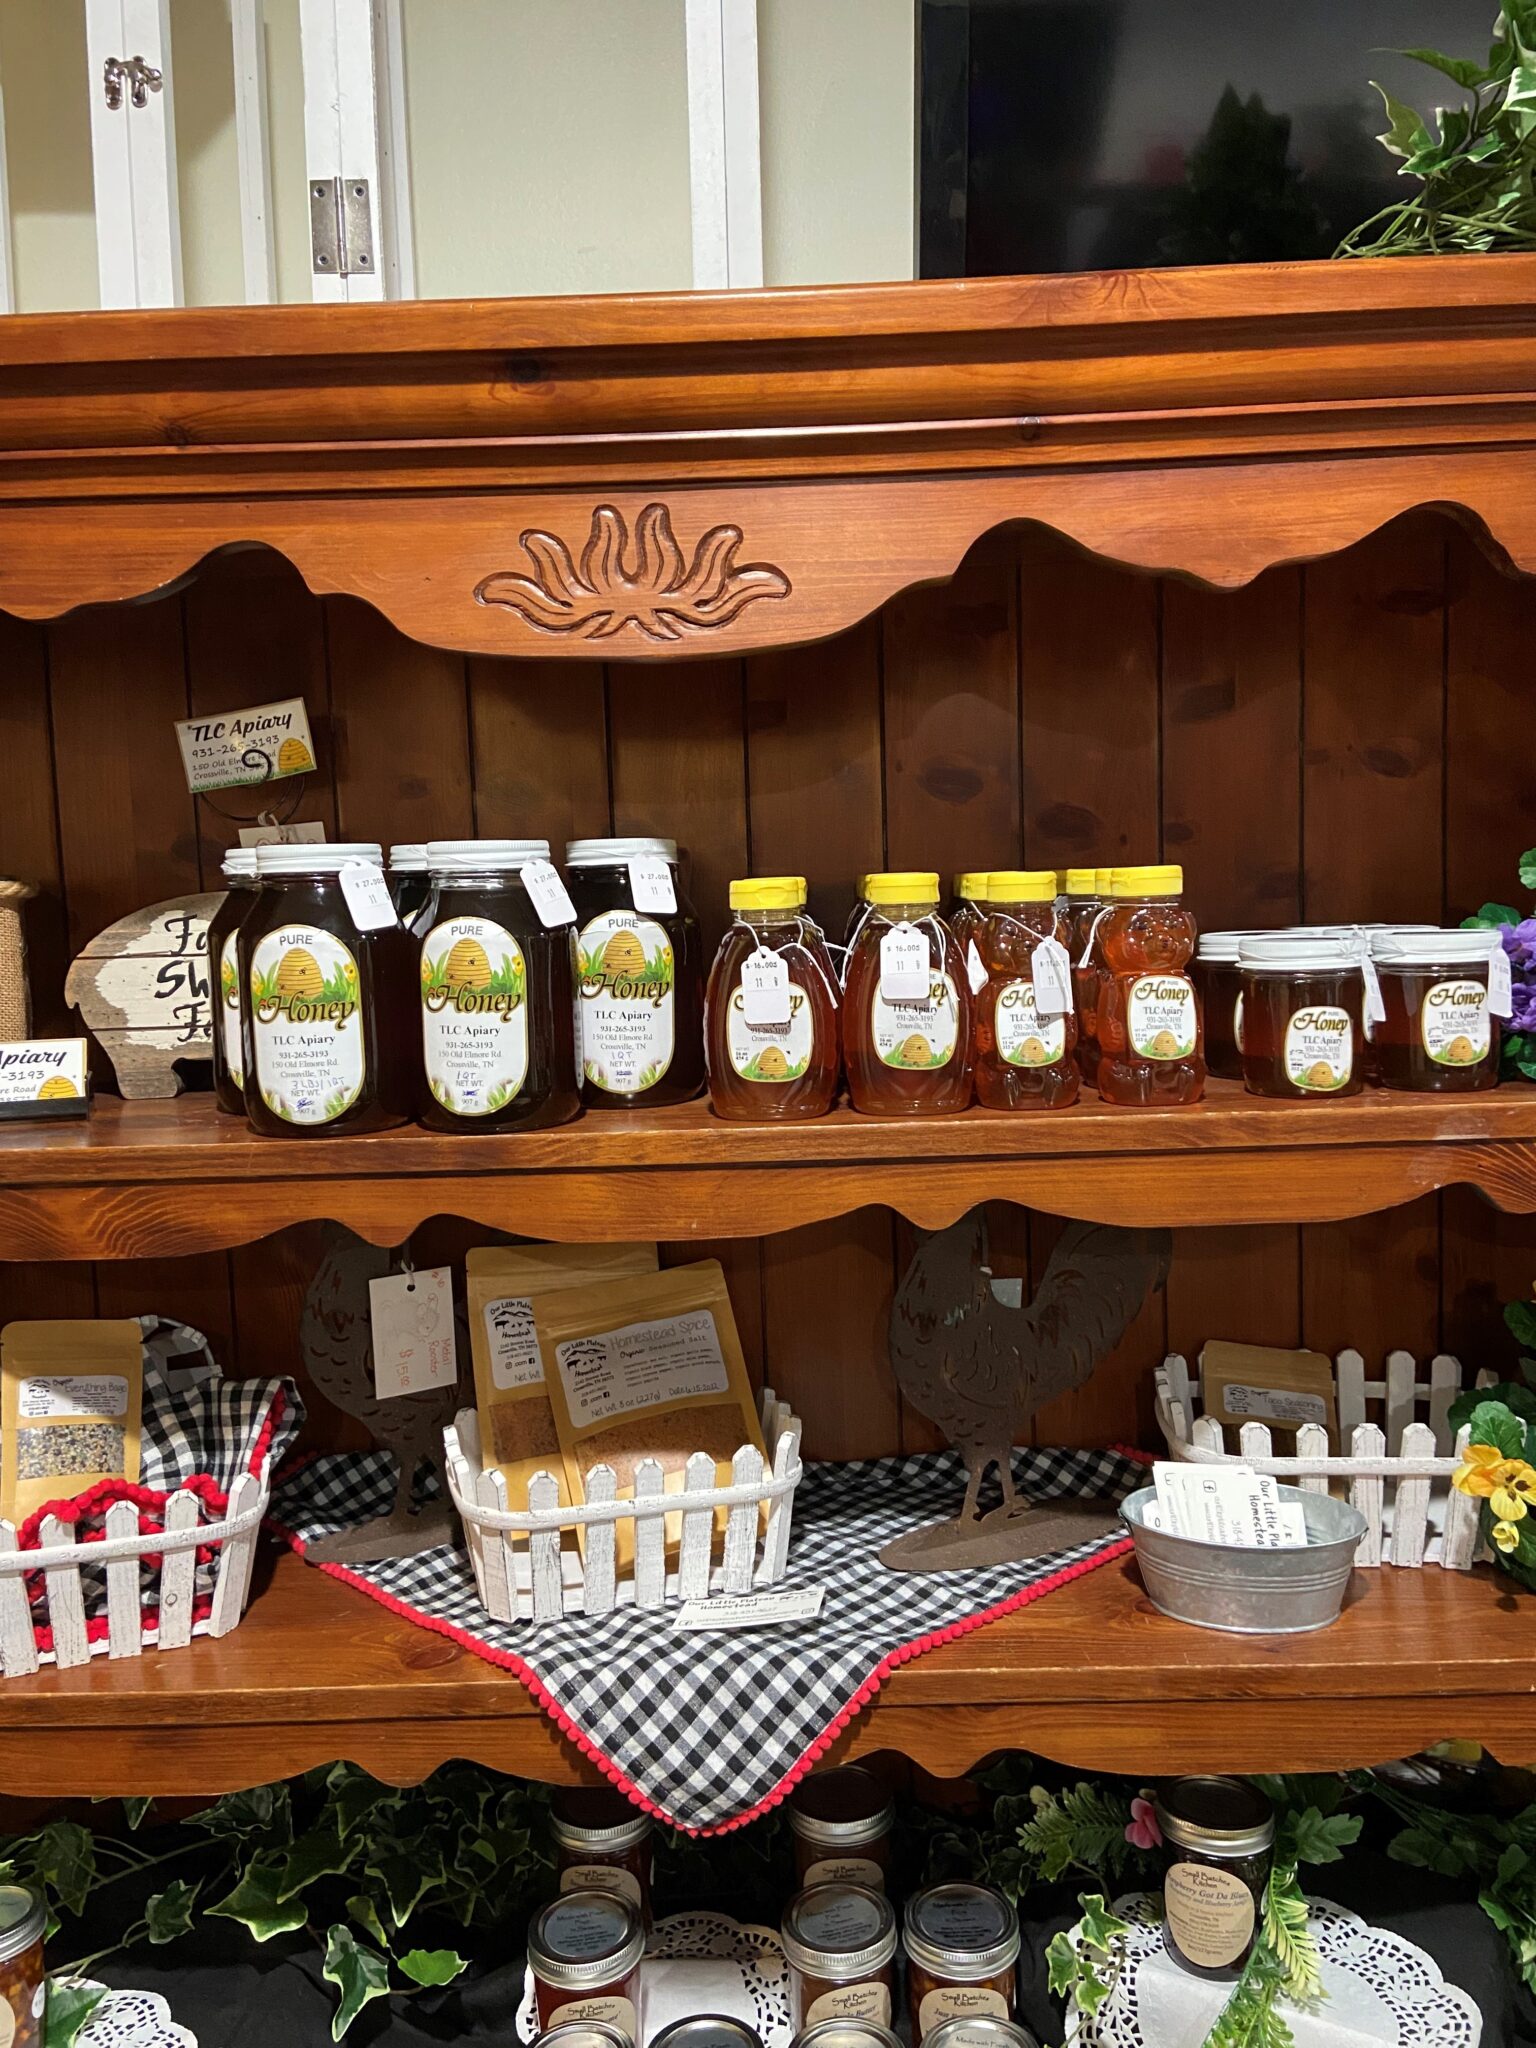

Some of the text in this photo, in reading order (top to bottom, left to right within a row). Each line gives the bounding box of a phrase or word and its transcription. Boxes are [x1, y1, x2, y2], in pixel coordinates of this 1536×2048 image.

[192, 713, 292, 742] TLC Apiary
[191, 735, 280, 759] 931-265-3193
[212, 759, 226, 769] Old
[235, 766, 246, 774] TN
[608, 918, 639, 928] PURE
[451, 925, 483, 936] PURE
[280, 934, 313, 946] PURE
[580, 970, 669, 1008] Honey
[1135, 980, 1189, 1006] Honey
[426, 981, 520, 1022] Honey
[1429, 985, 1485, 1010] Honey
[257, 991, 355, 1030] Honey
[892, 1003, 938, 1015] TLC Apiary
[1144, 1007, 1184, 1016] TLC Apiary
[594, 1011, 652, 1021] TLC Apiary
[1010, 1013, 1051, 1023] TLC Apiary
[1458, 1011, 1480, 1021] Apiary
[1294, 1011, 1348, 1037] Honey
[440, 1025, 501, 1037] TLC Apiary
[272, 1034, 335, 1046] TLC Apiary
[605, 1033, 617, 1041] Old
[1302, 1036, 1342, 1046] TLC Apiary
[445, 1041, 494, 1049] 931-265-3193
[279, 1050, 329, 1059] 931-265-3193
[450, 1050, 463, 1058] Old
[464, 1050, 489, 1058] Elmore
[285, 1060, 297, 1068] Old
[0, 1070, 45, 1081] -3193
[13, 1084, 37, 1094] Road
[609, 1318, 711, 1351] Homestead Spice
[1260, 1480, 1270, 1498] Our
[1263, 1502, 1278, 1530] Little
[1193, 1877, 1217, 1888] Kitchen
[1200, 1890, 1214, 1898] Got
[843, 1999, 867, 2010] Kitchen
[956, 2036, 974, 2045] Made
